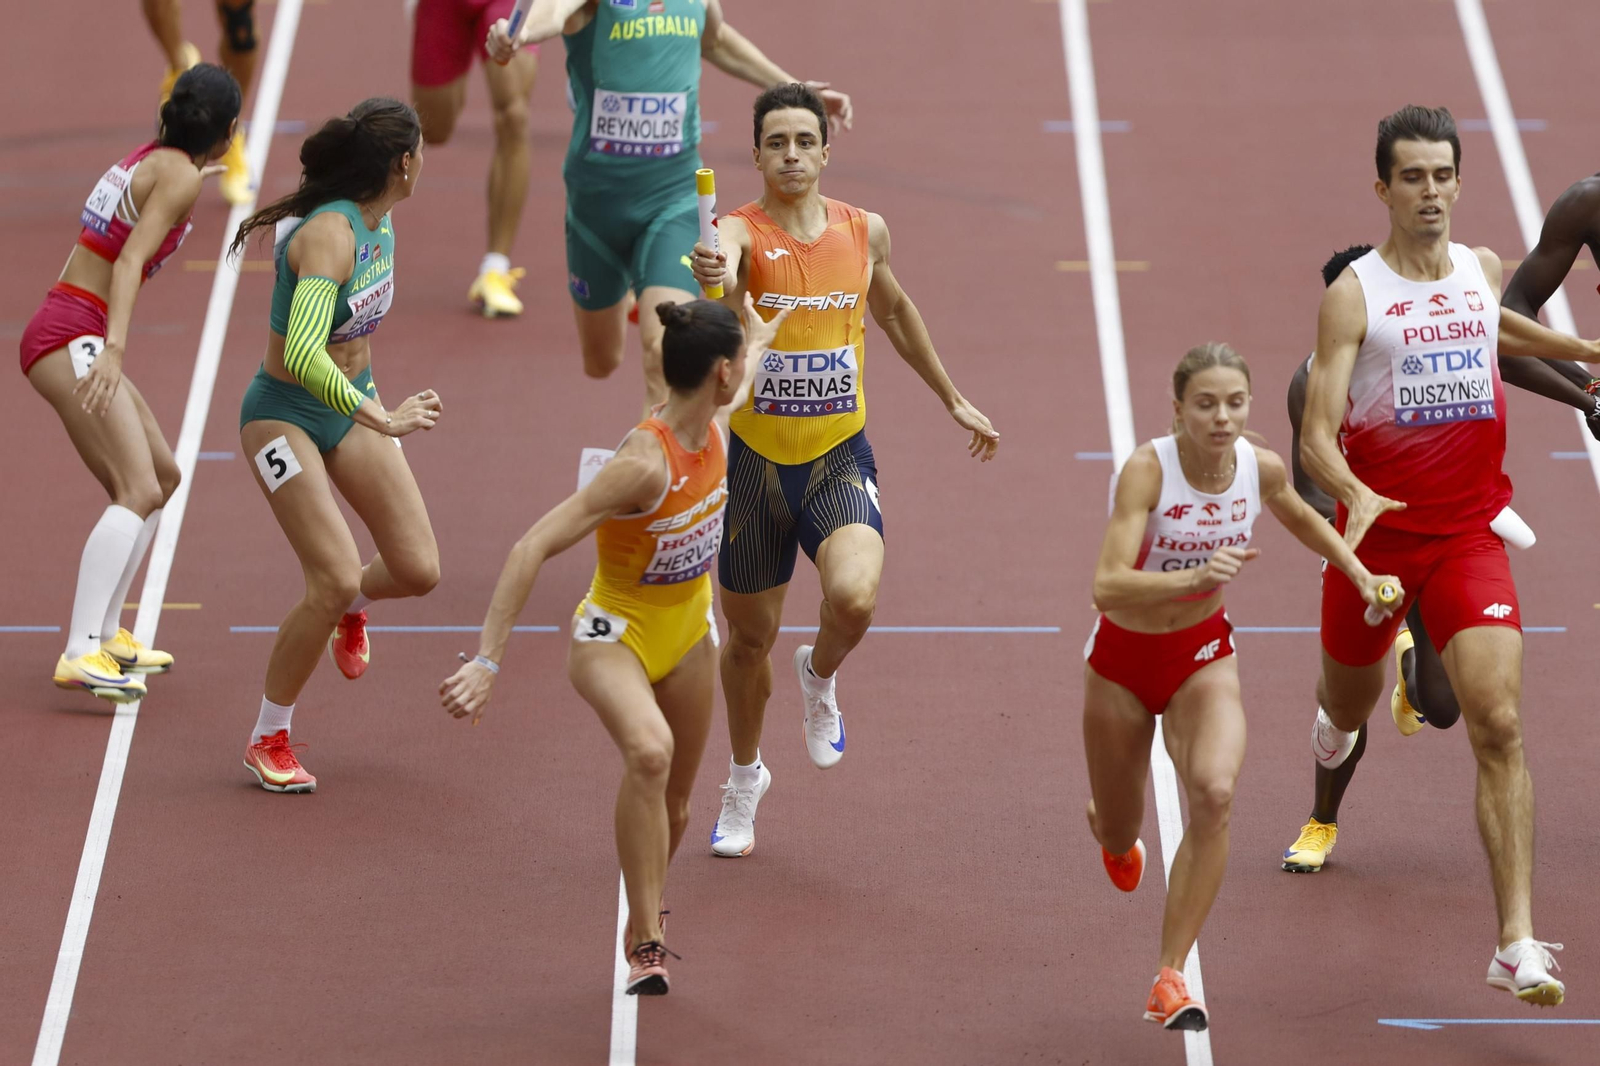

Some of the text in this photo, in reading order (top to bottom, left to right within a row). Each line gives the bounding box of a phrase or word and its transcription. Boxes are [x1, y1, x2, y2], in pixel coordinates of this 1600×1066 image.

[610, 15, 697, 41] AUSTRALIA
[621, 97, 678, 115] TDK
[596, 116, 678, 138] REYNOLDS
[757, 291, 860, 311] ESPAÑA
[1385, 300, 1414, 318] 4F
[1428, 308, 1455, 317] ORLEN
[349, 300, 383, 331] BULL
[1403, 320, 1486, 346] POLSKA
[785, 348, 851, 373] TDK
[1423, 347, 1484, 374] TDK
[760, 374, 852, 398] ARENAS
[1399, 376, 1491, 406] DUSZYŃSKI
[264, 446, 287, 479] 5
[1163, 503, 1193, 520] 4F
[1156, 532, 1248, 552] HONDA
[1483, 602, 1513, 619] 4F
[586, 616, 612, 639] 9
[1194, 638, 1220, 662] 4F
